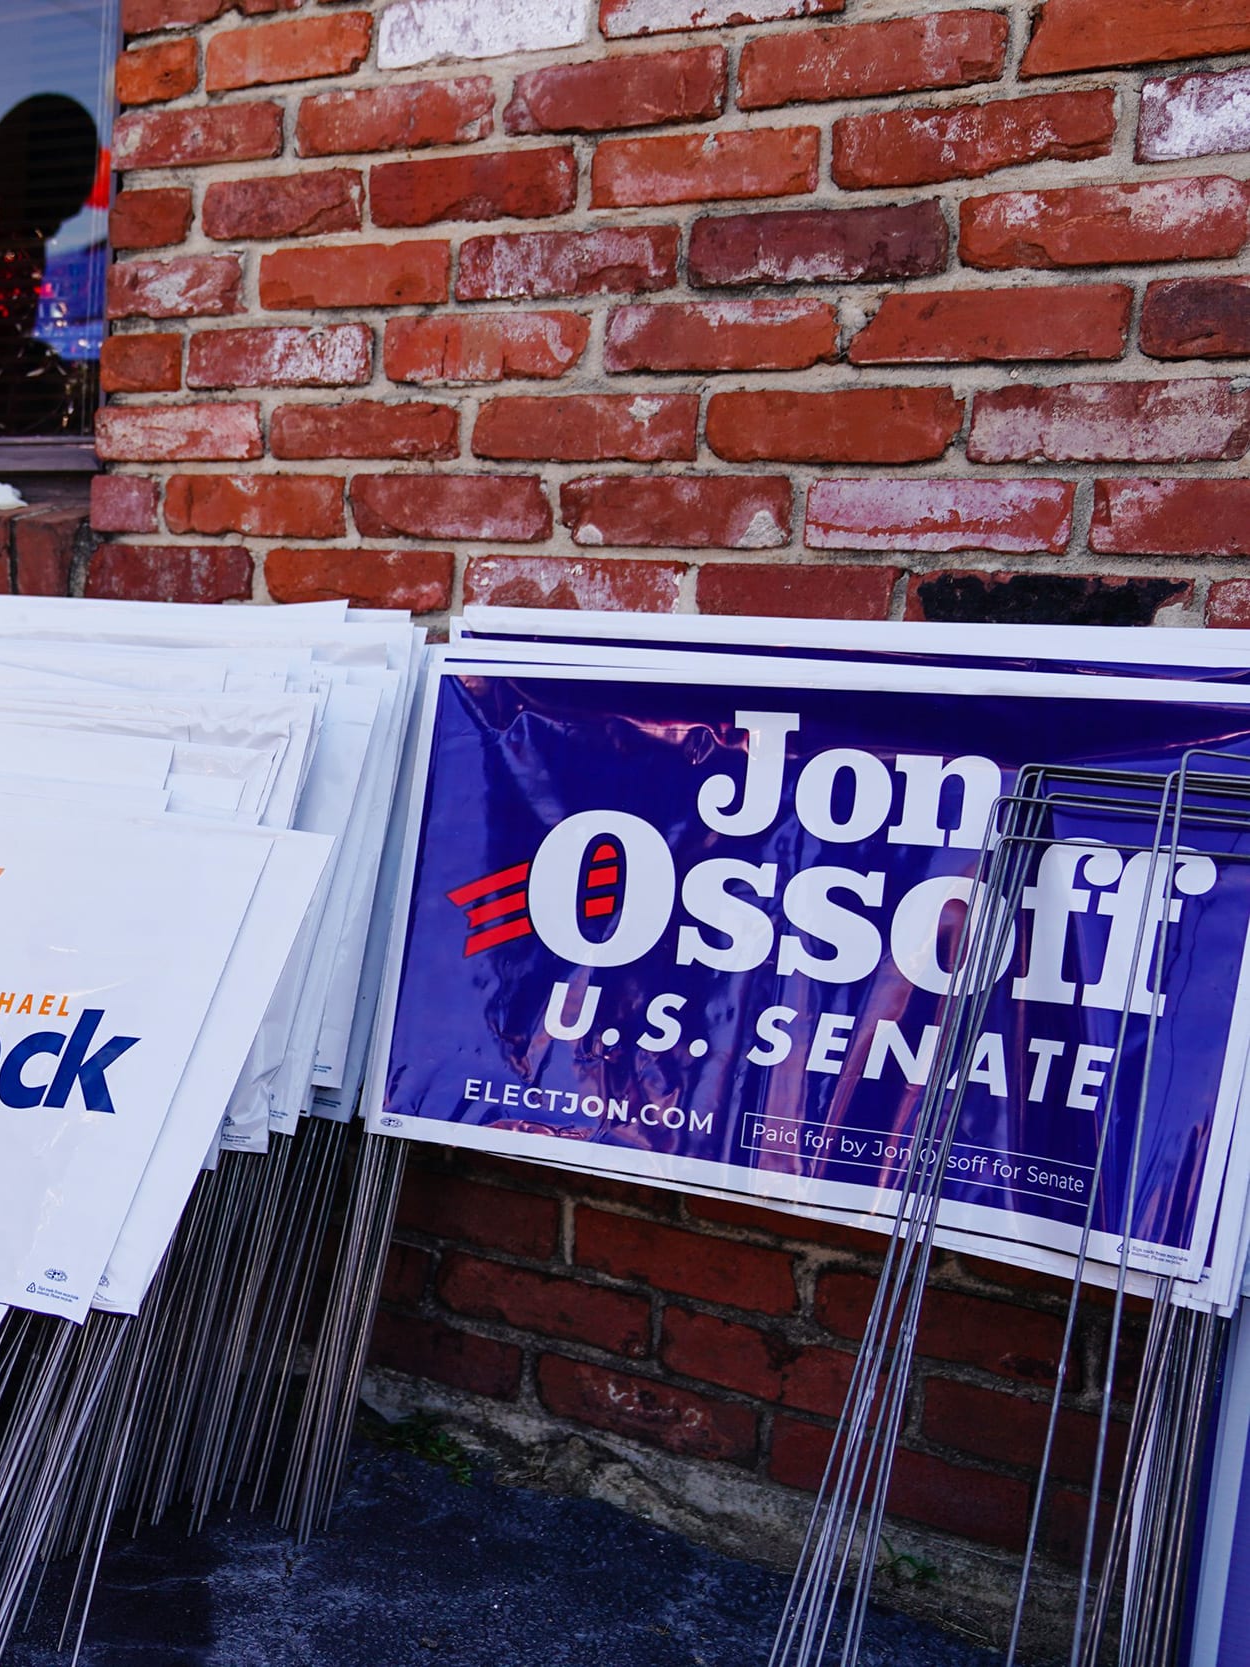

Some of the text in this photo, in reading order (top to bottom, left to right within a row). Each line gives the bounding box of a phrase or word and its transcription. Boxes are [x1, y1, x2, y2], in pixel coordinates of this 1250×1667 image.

[697, 710, 1000, 851] Jon
[527, 809, 1216, 1018] Ossoff
[463, 1078, 714, 1136] ELECTJON.COM
[545, 981, 1116, 1112] U.S. SENATE
[752, 1122, 1085, 1194] Paid for by Jon Osoff for Senate
